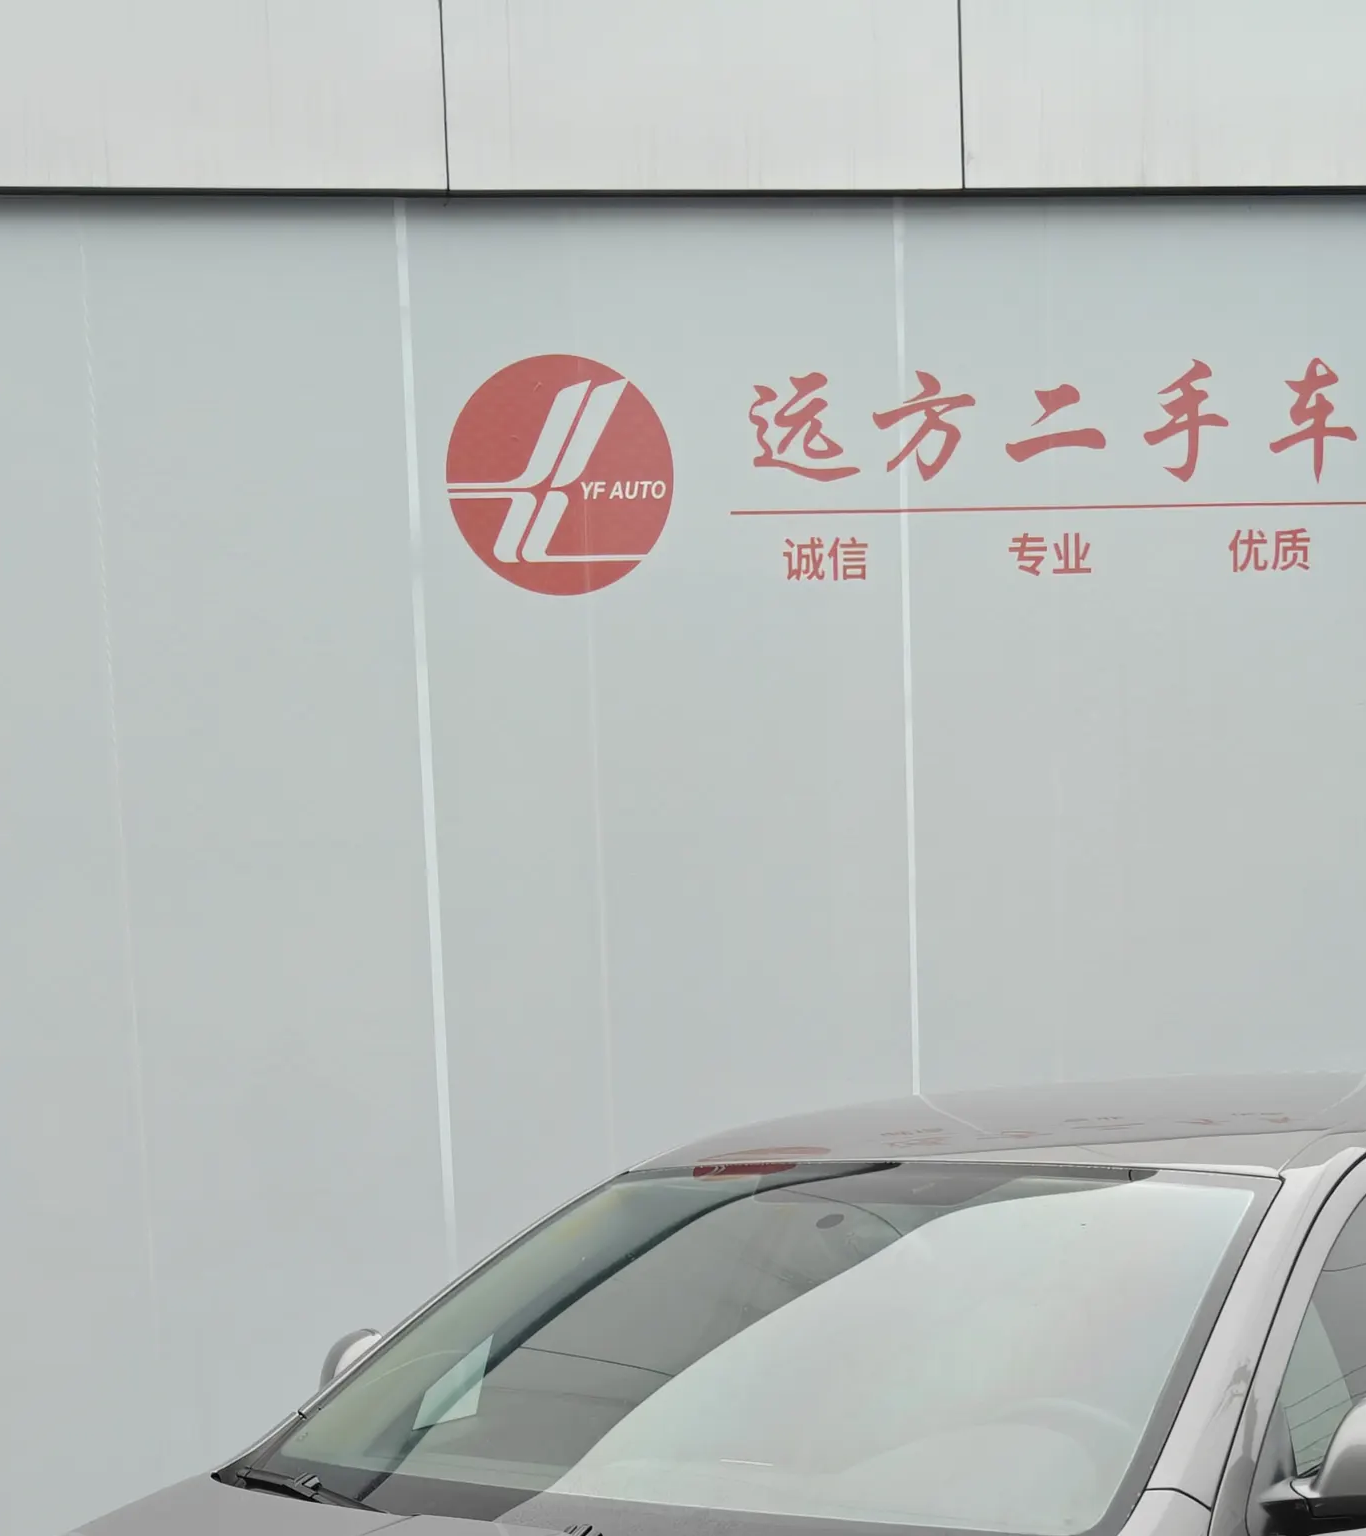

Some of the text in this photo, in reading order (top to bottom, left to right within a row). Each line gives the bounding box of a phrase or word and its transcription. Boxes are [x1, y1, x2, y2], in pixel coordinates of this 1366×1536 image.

[748, 356, 1359, 483] 远方二手车
[580, 479, 666, 500] YF AUTO
[783, 527, 1311, 582] 诚信 专业 优质
